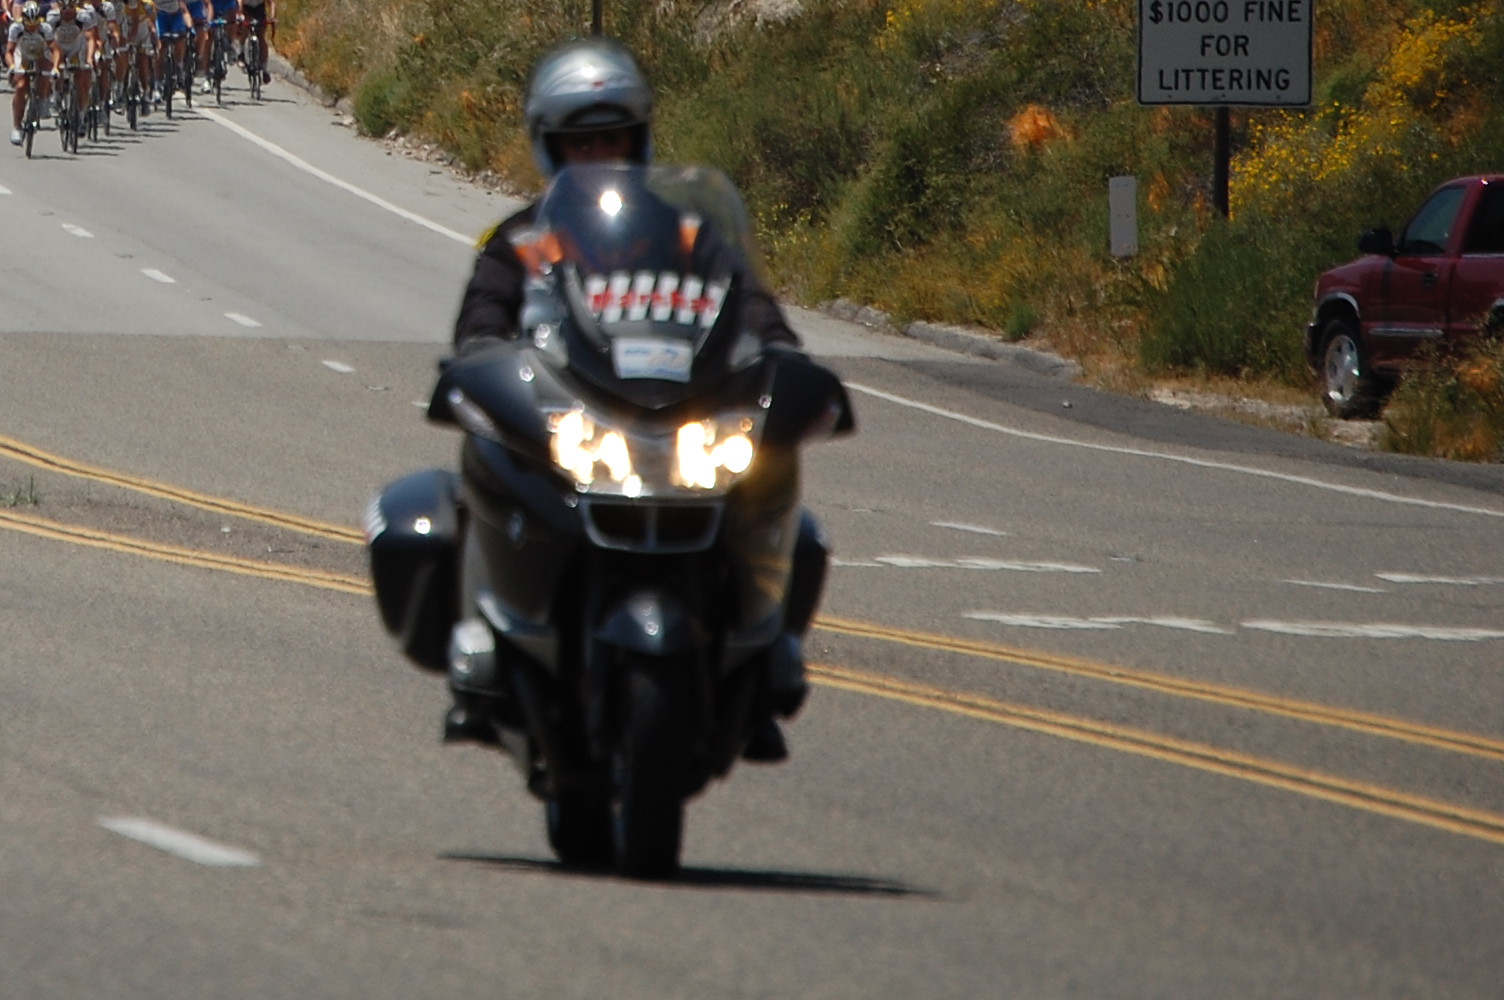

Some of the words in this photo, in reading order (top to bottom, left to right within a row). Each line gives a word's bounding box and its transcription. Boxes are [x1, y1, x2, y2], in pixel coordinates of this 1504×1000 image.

[1244, 0, 1302, 23] FINE
[1200, 35, 1250, 57] FOR
[1158, 68, 1291, 91] LITTERING
